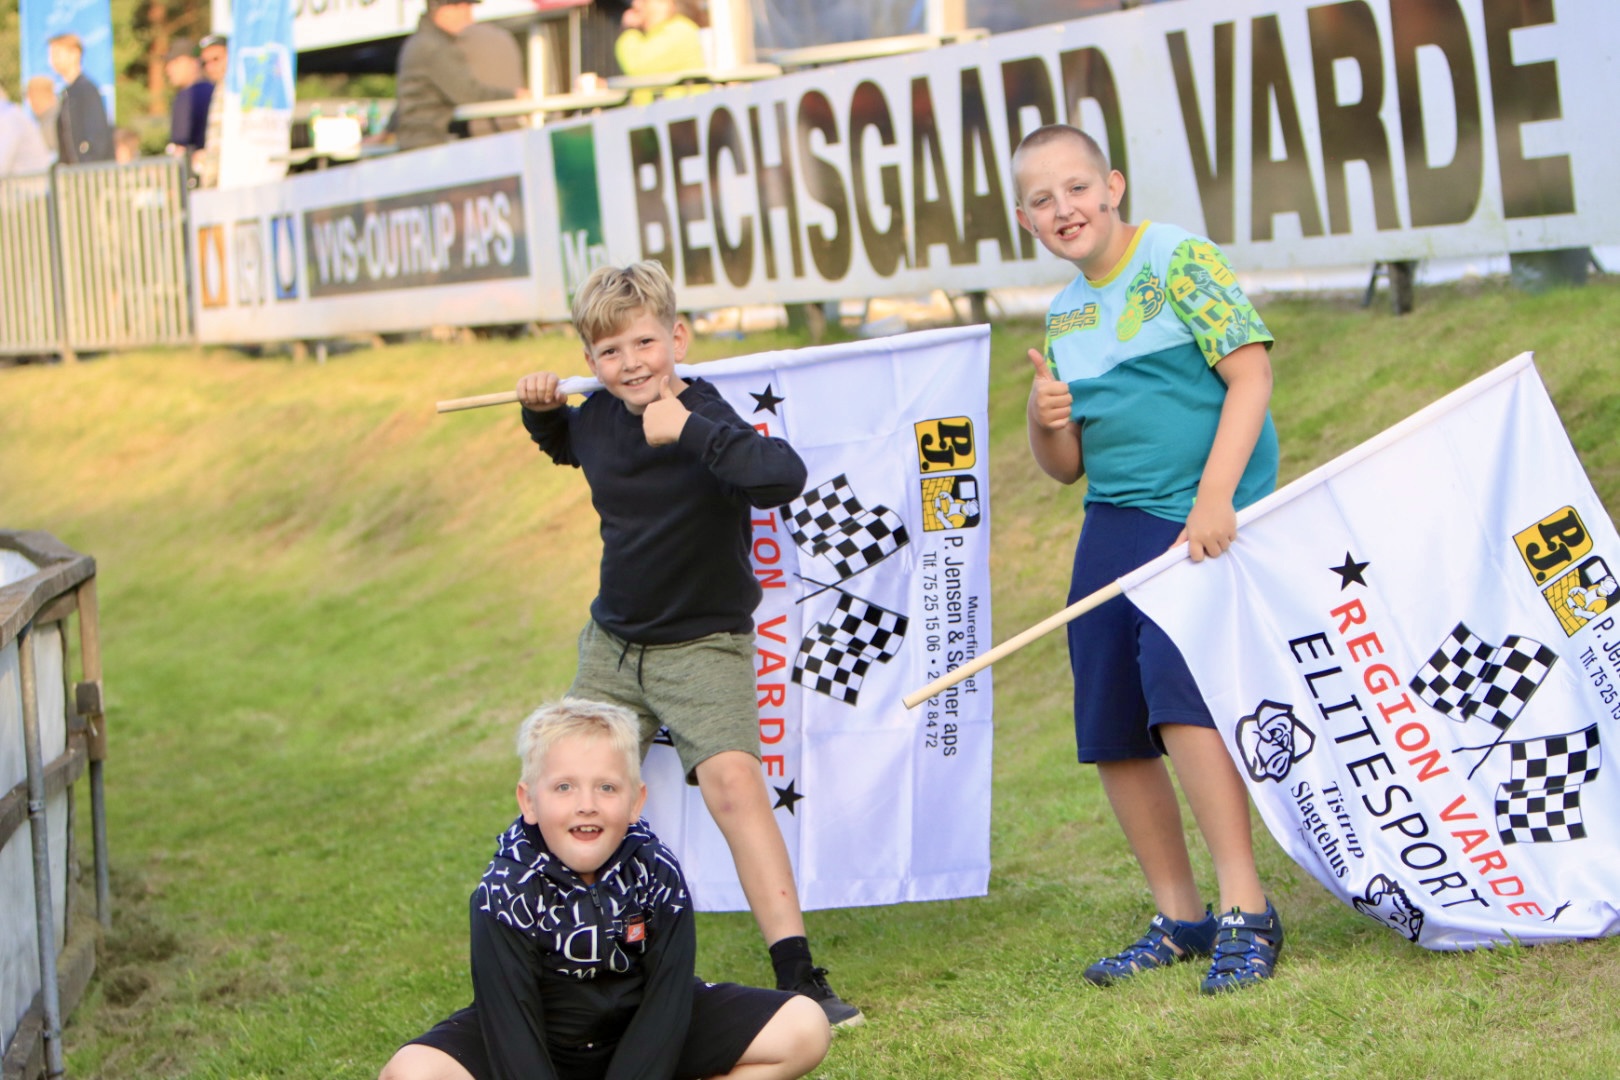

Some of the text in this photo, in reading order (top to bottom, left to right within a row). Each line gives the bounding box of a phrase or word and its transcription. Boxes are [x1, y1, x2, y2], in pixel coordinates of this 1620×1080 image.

[1166, 0, 1577, 245] VARDE
[463, 191, 516, 268] APS
[922, 551, 937, 570] Tlf.
[923, 575, 937, 591] 75
[924, 595, 939, 612] 25
[925, 616, 940, 631] 15
[926, 635, 941, 652] 06
[943, 536, 964, 757] P. Jensen & Søner aps
[965, 596, 979, 694] Murerfiret
[1592, 616, 1615, 639] P.
[1580, 646, 1598, 670] Tlf.
[1590, 666, 1608, 687] 75
[1600, 683, 1618, 704] 25
[925, 711, 940, 728] 84
[925, 732, 939, 749] 72
[1329, 597, 1546, 917] REGION VARDE
[1288, 632, 1490, 909] ELITESPORT
[1290, 781, 1349, 879] Slagtehus
[1322, 781, 1365, 859] Tistrup
[1221, 914, 1245, 927] FILA
